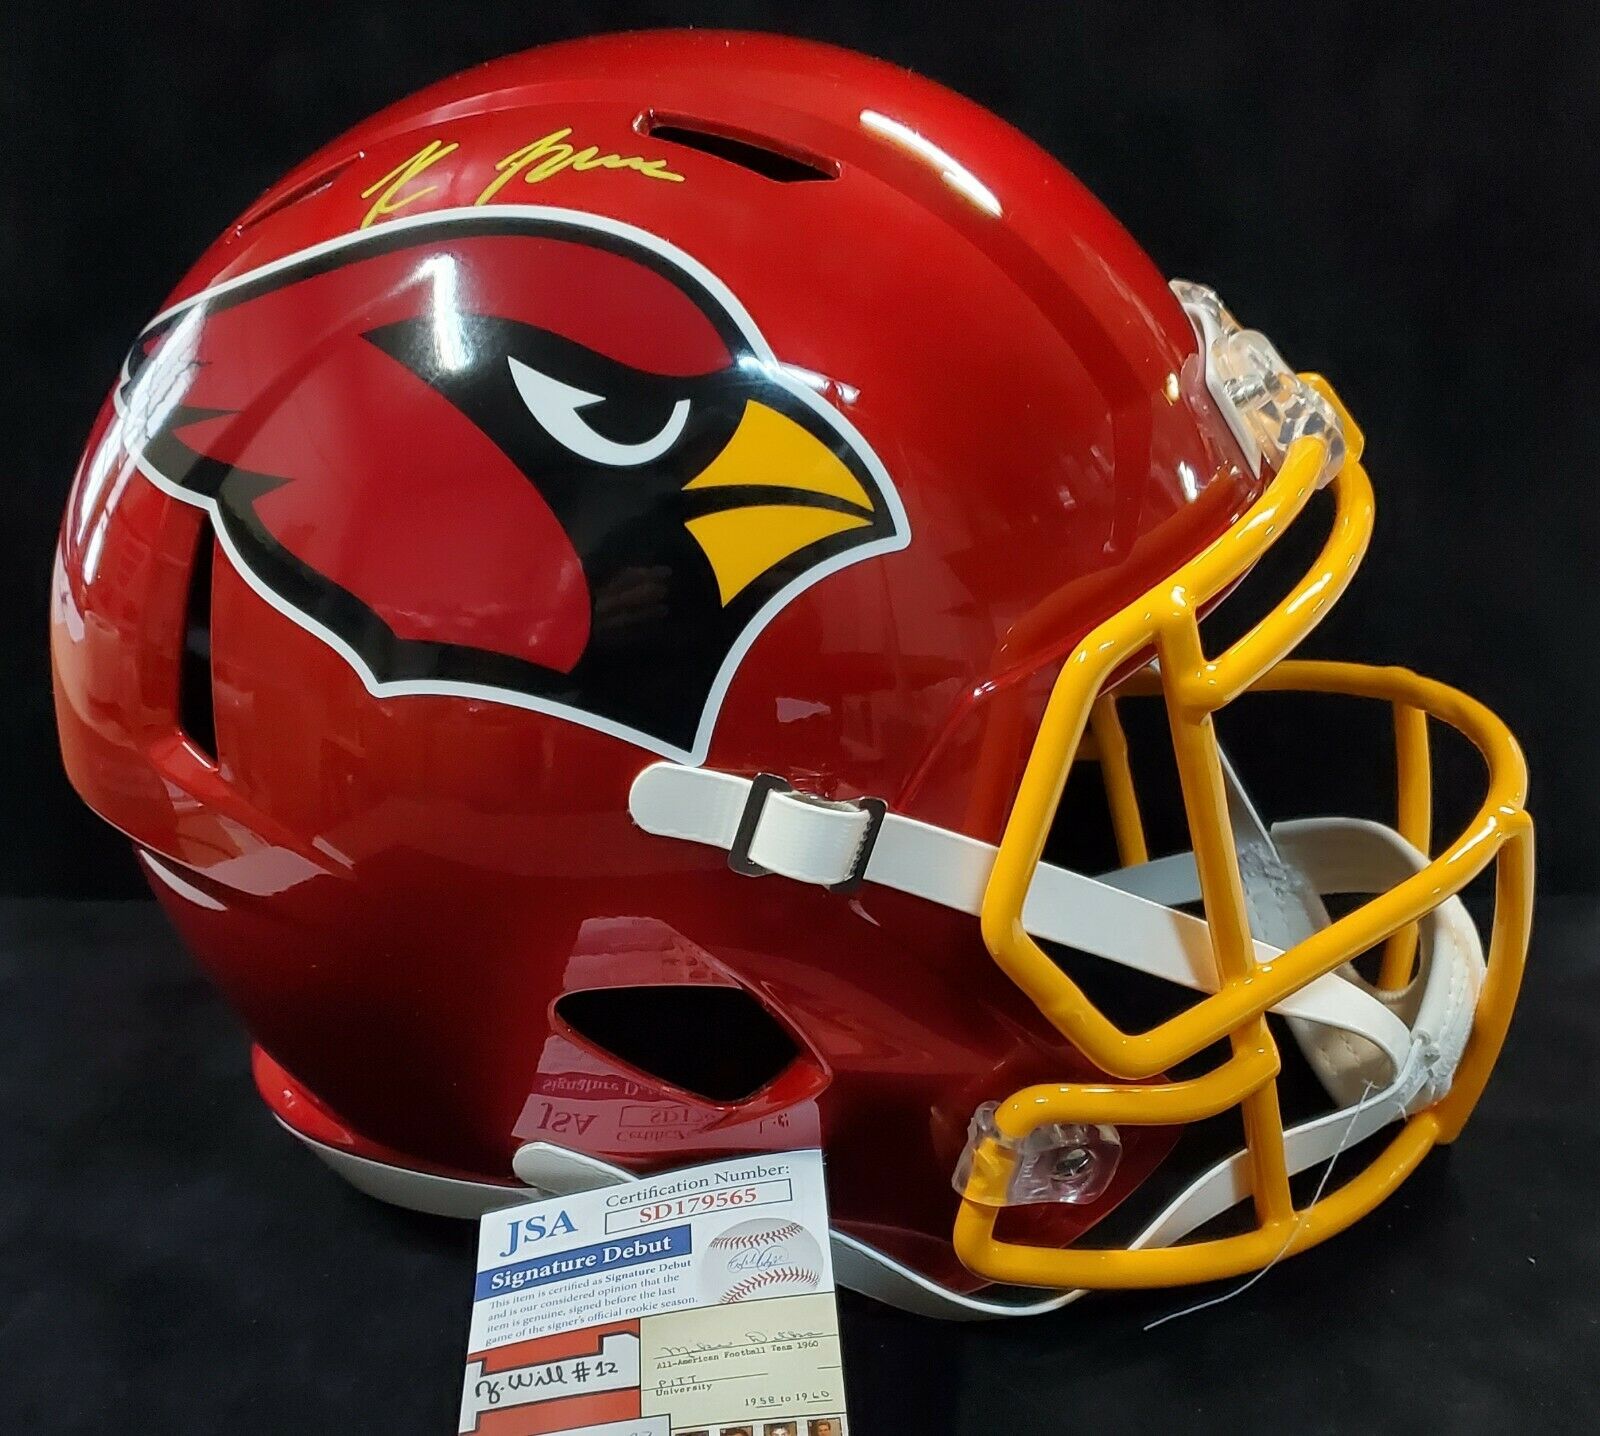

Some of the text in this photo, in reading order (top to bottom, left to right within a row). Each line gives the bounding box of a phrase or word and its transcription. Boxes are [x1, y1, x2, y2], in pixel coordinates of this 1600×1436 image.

[606, 1164, 790, 1207] Certification Number:
[640, 1187, 757, 1223] SD179565
[500, 1210, 579, 1257] JSA
[490, 1299, 510, 1310] This
[513, 1293, 535, 1304] item
[538, 1290, 546, 1298] is
[549, 1279, 590, 1295] certified
[605, 1267, 656, 1283] Signature
[659, 1260, 691, 1272] Debut
[491, 1236, 672, 1290] Signature Debut
[487, 1322, 509, 1333] item
[523, 1310, 566, 1326] genuine,
[569, 1300, 601, 1314] signed
[605, 1294, 637, 1306] before
[640, 1290, 656, 1300] the
[658, 1286, 676, 1297] last
[488, 1309, 507, 1321] and
[520, 1304, 537, 1313] our
[540, 1289, 595, 1308] considered
[597, 1283, 637, 1297] opinion
[641, 1278, 660, 1288] that
[663, 1274, 680, 1283] the
[485, 1333, 513, 1347] game
[515, 1328, 526, 1337] of
[528, 1325, 545, 1335] the
[587, 1307, 622, 1322] official
[625, 1302, 658, 1315] rookie
[661, 1297, 698, 1308] season.
[656, 1340, 819, 1370] All-American Football Team 1960
[656, 1383, 713, 1397] University
[658, 1375, 697, 1388] PITT
[781, 1394, 791, 1403] to
